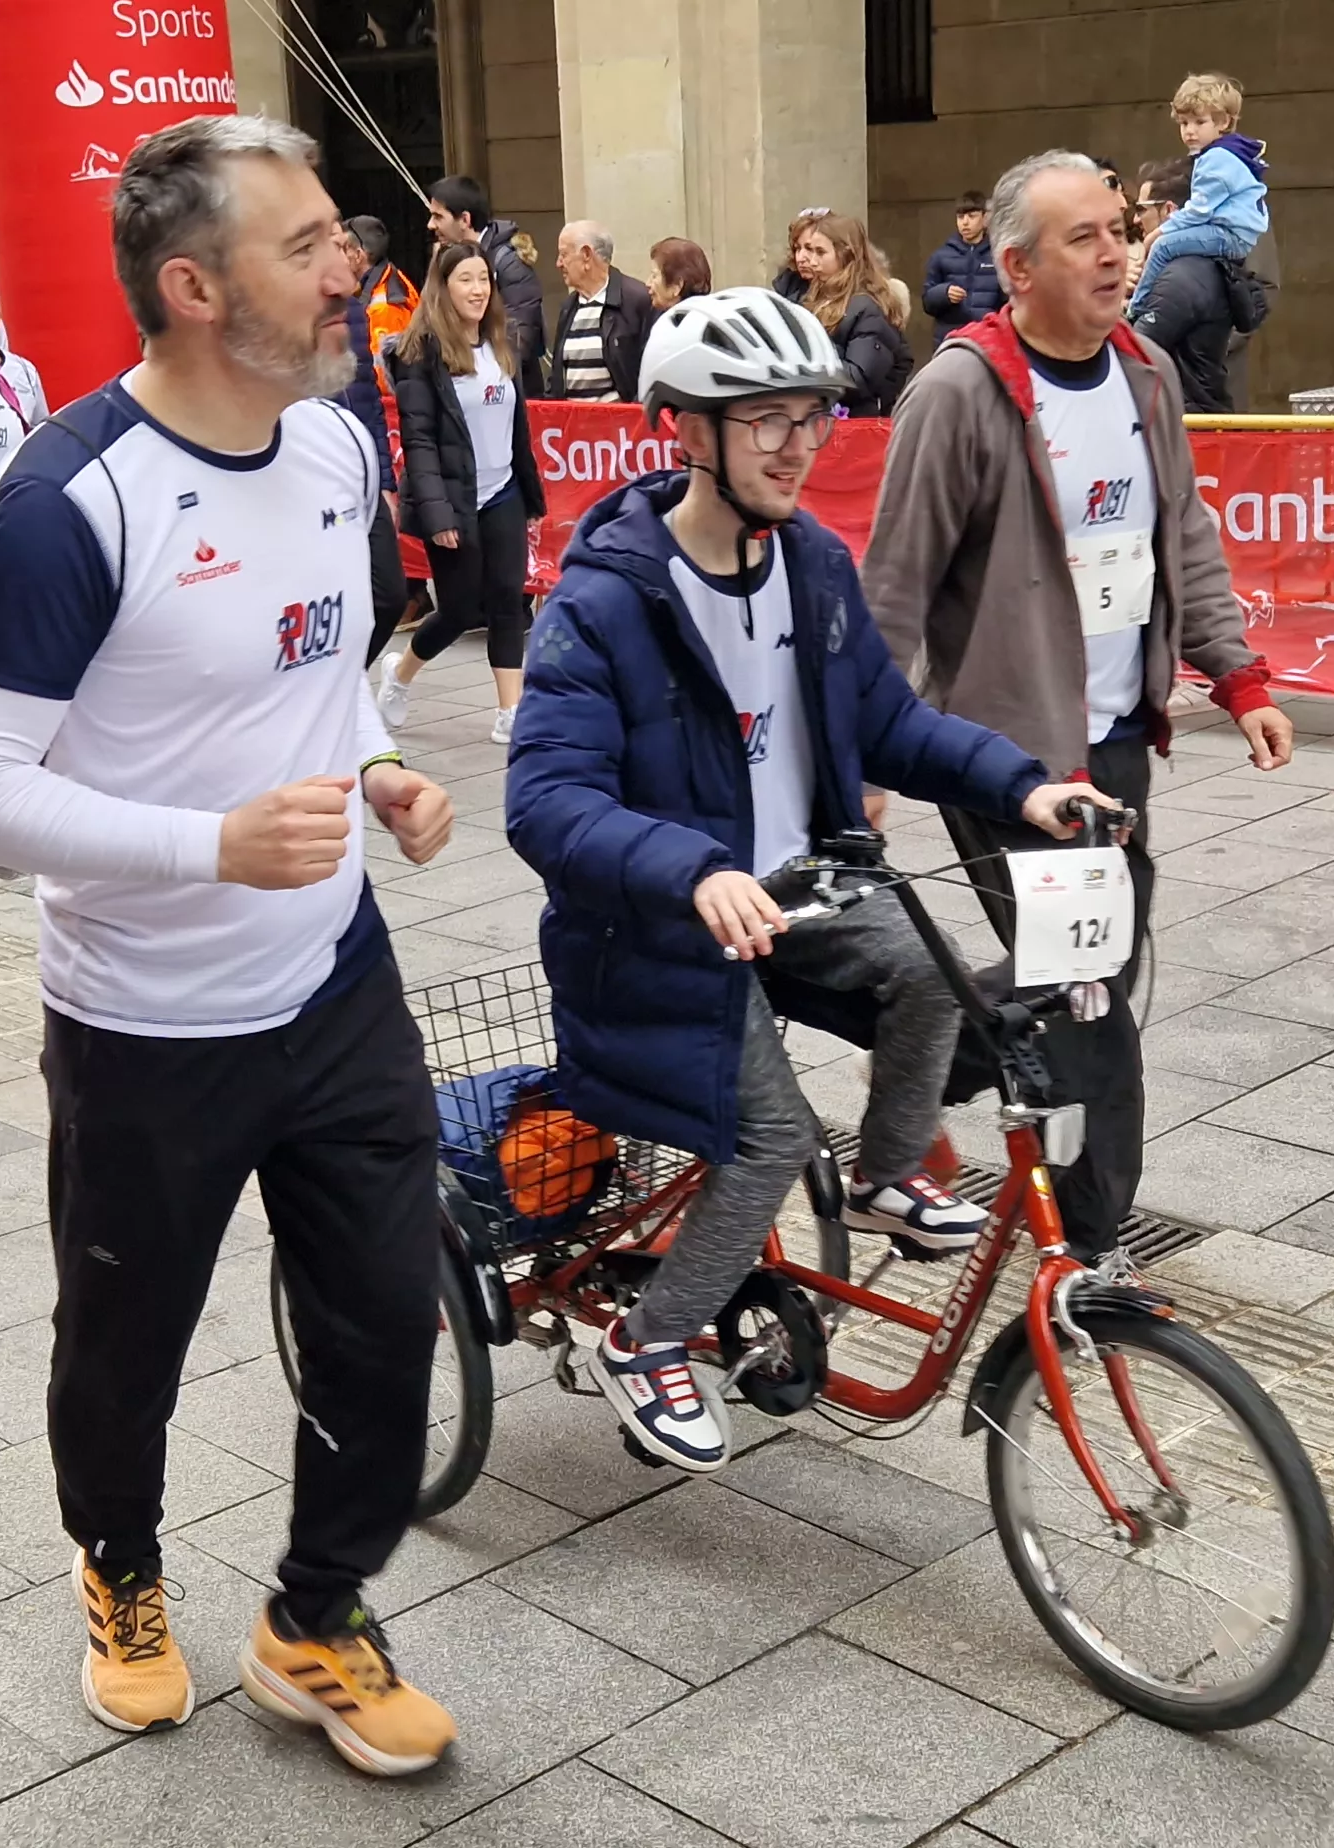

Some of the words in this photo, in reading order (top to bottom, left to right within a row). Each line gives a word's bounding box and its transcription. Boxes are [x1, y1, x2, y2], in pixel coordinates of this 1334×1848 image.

[112, 0, 214, 46] Sports
[175, 559, 242, 587] Santander
[1099, 586, 1112, 609] 5
